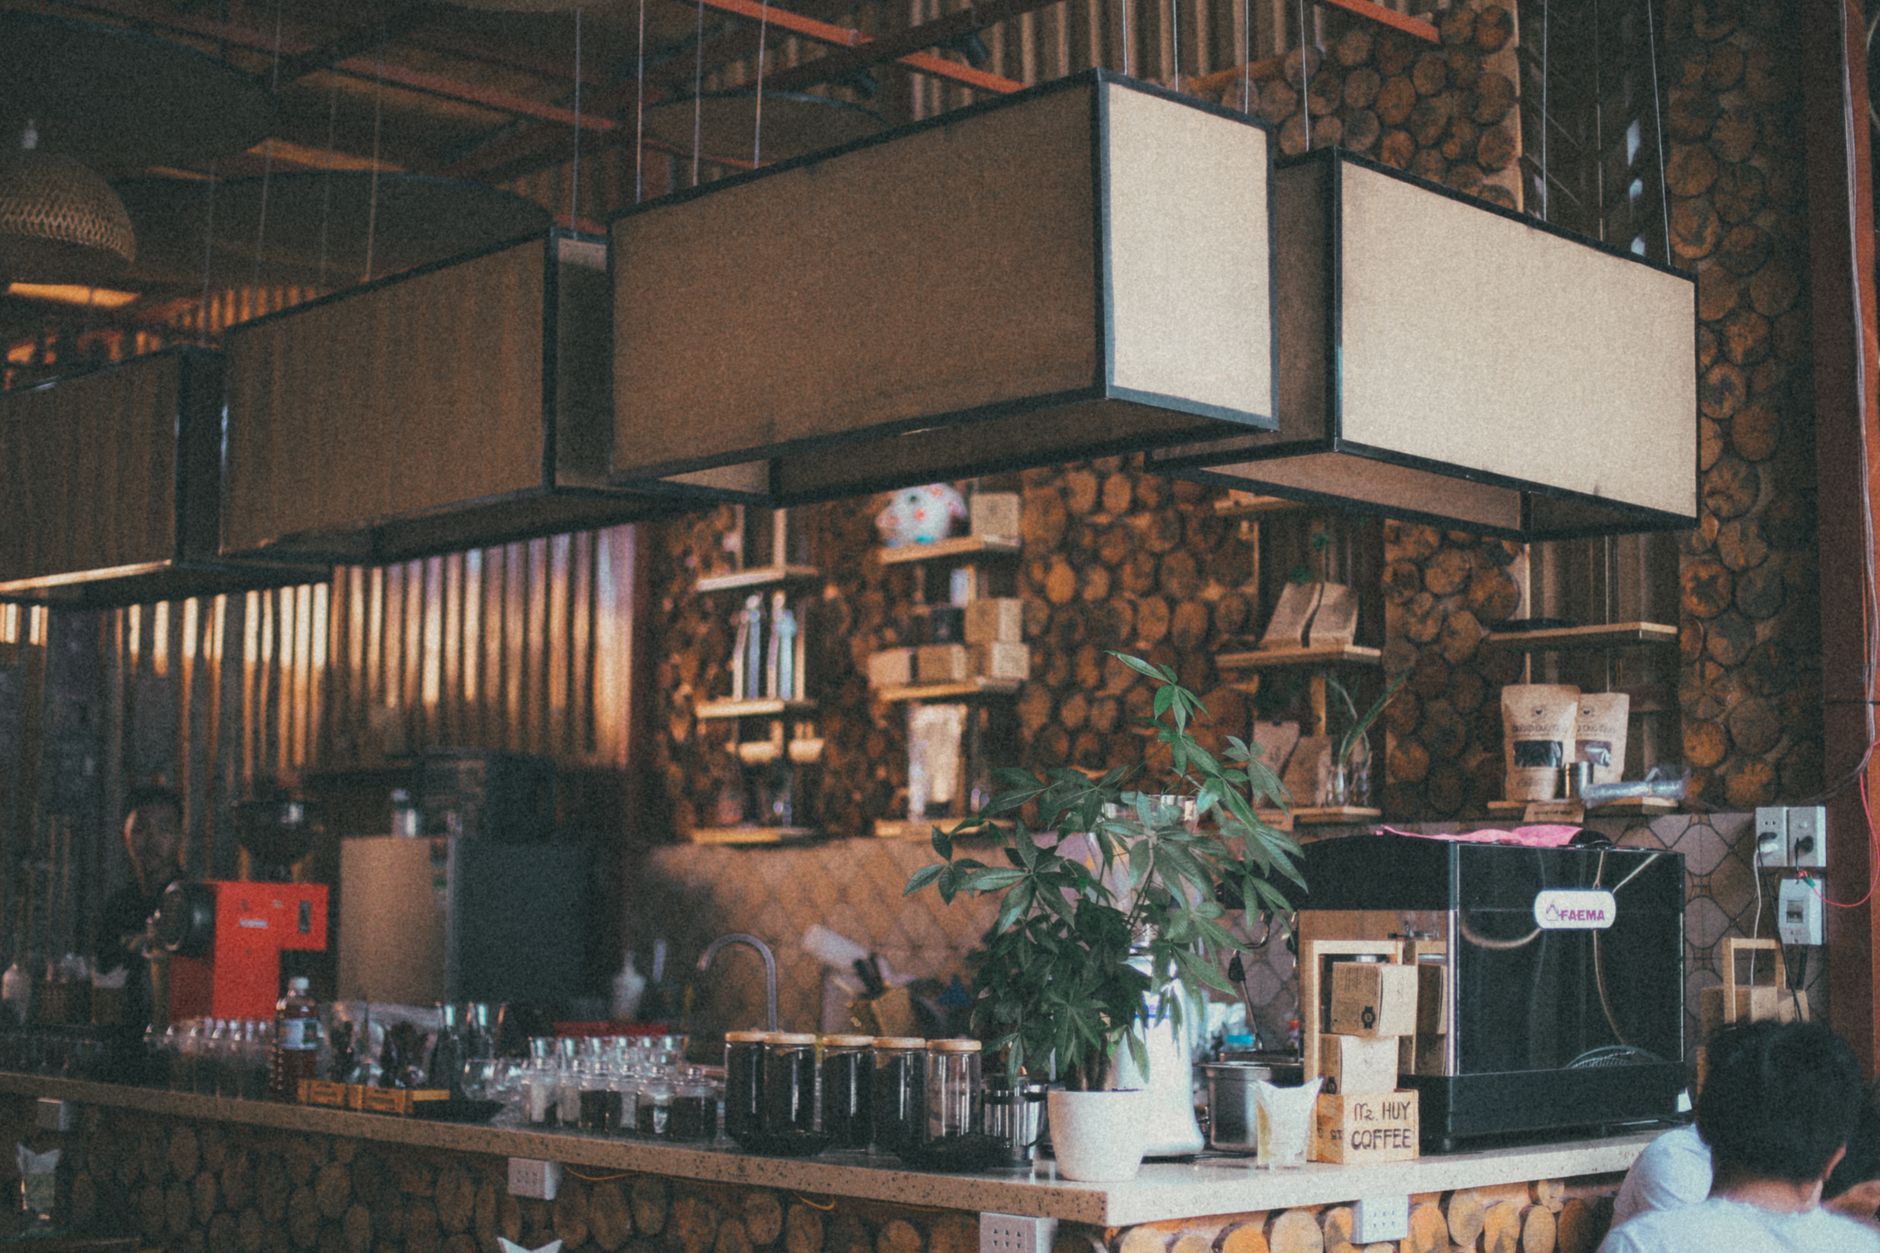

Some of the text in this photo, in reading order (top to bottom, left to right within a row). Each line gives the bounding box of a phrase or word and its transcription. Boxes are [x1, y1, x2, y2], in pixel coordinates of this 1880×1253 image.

[1559, 909, 1605, 921] FAEMA
[1382, 1101, 1411, 1121] HUY
[1351, 1128, 1412, 1151] COFFEE
